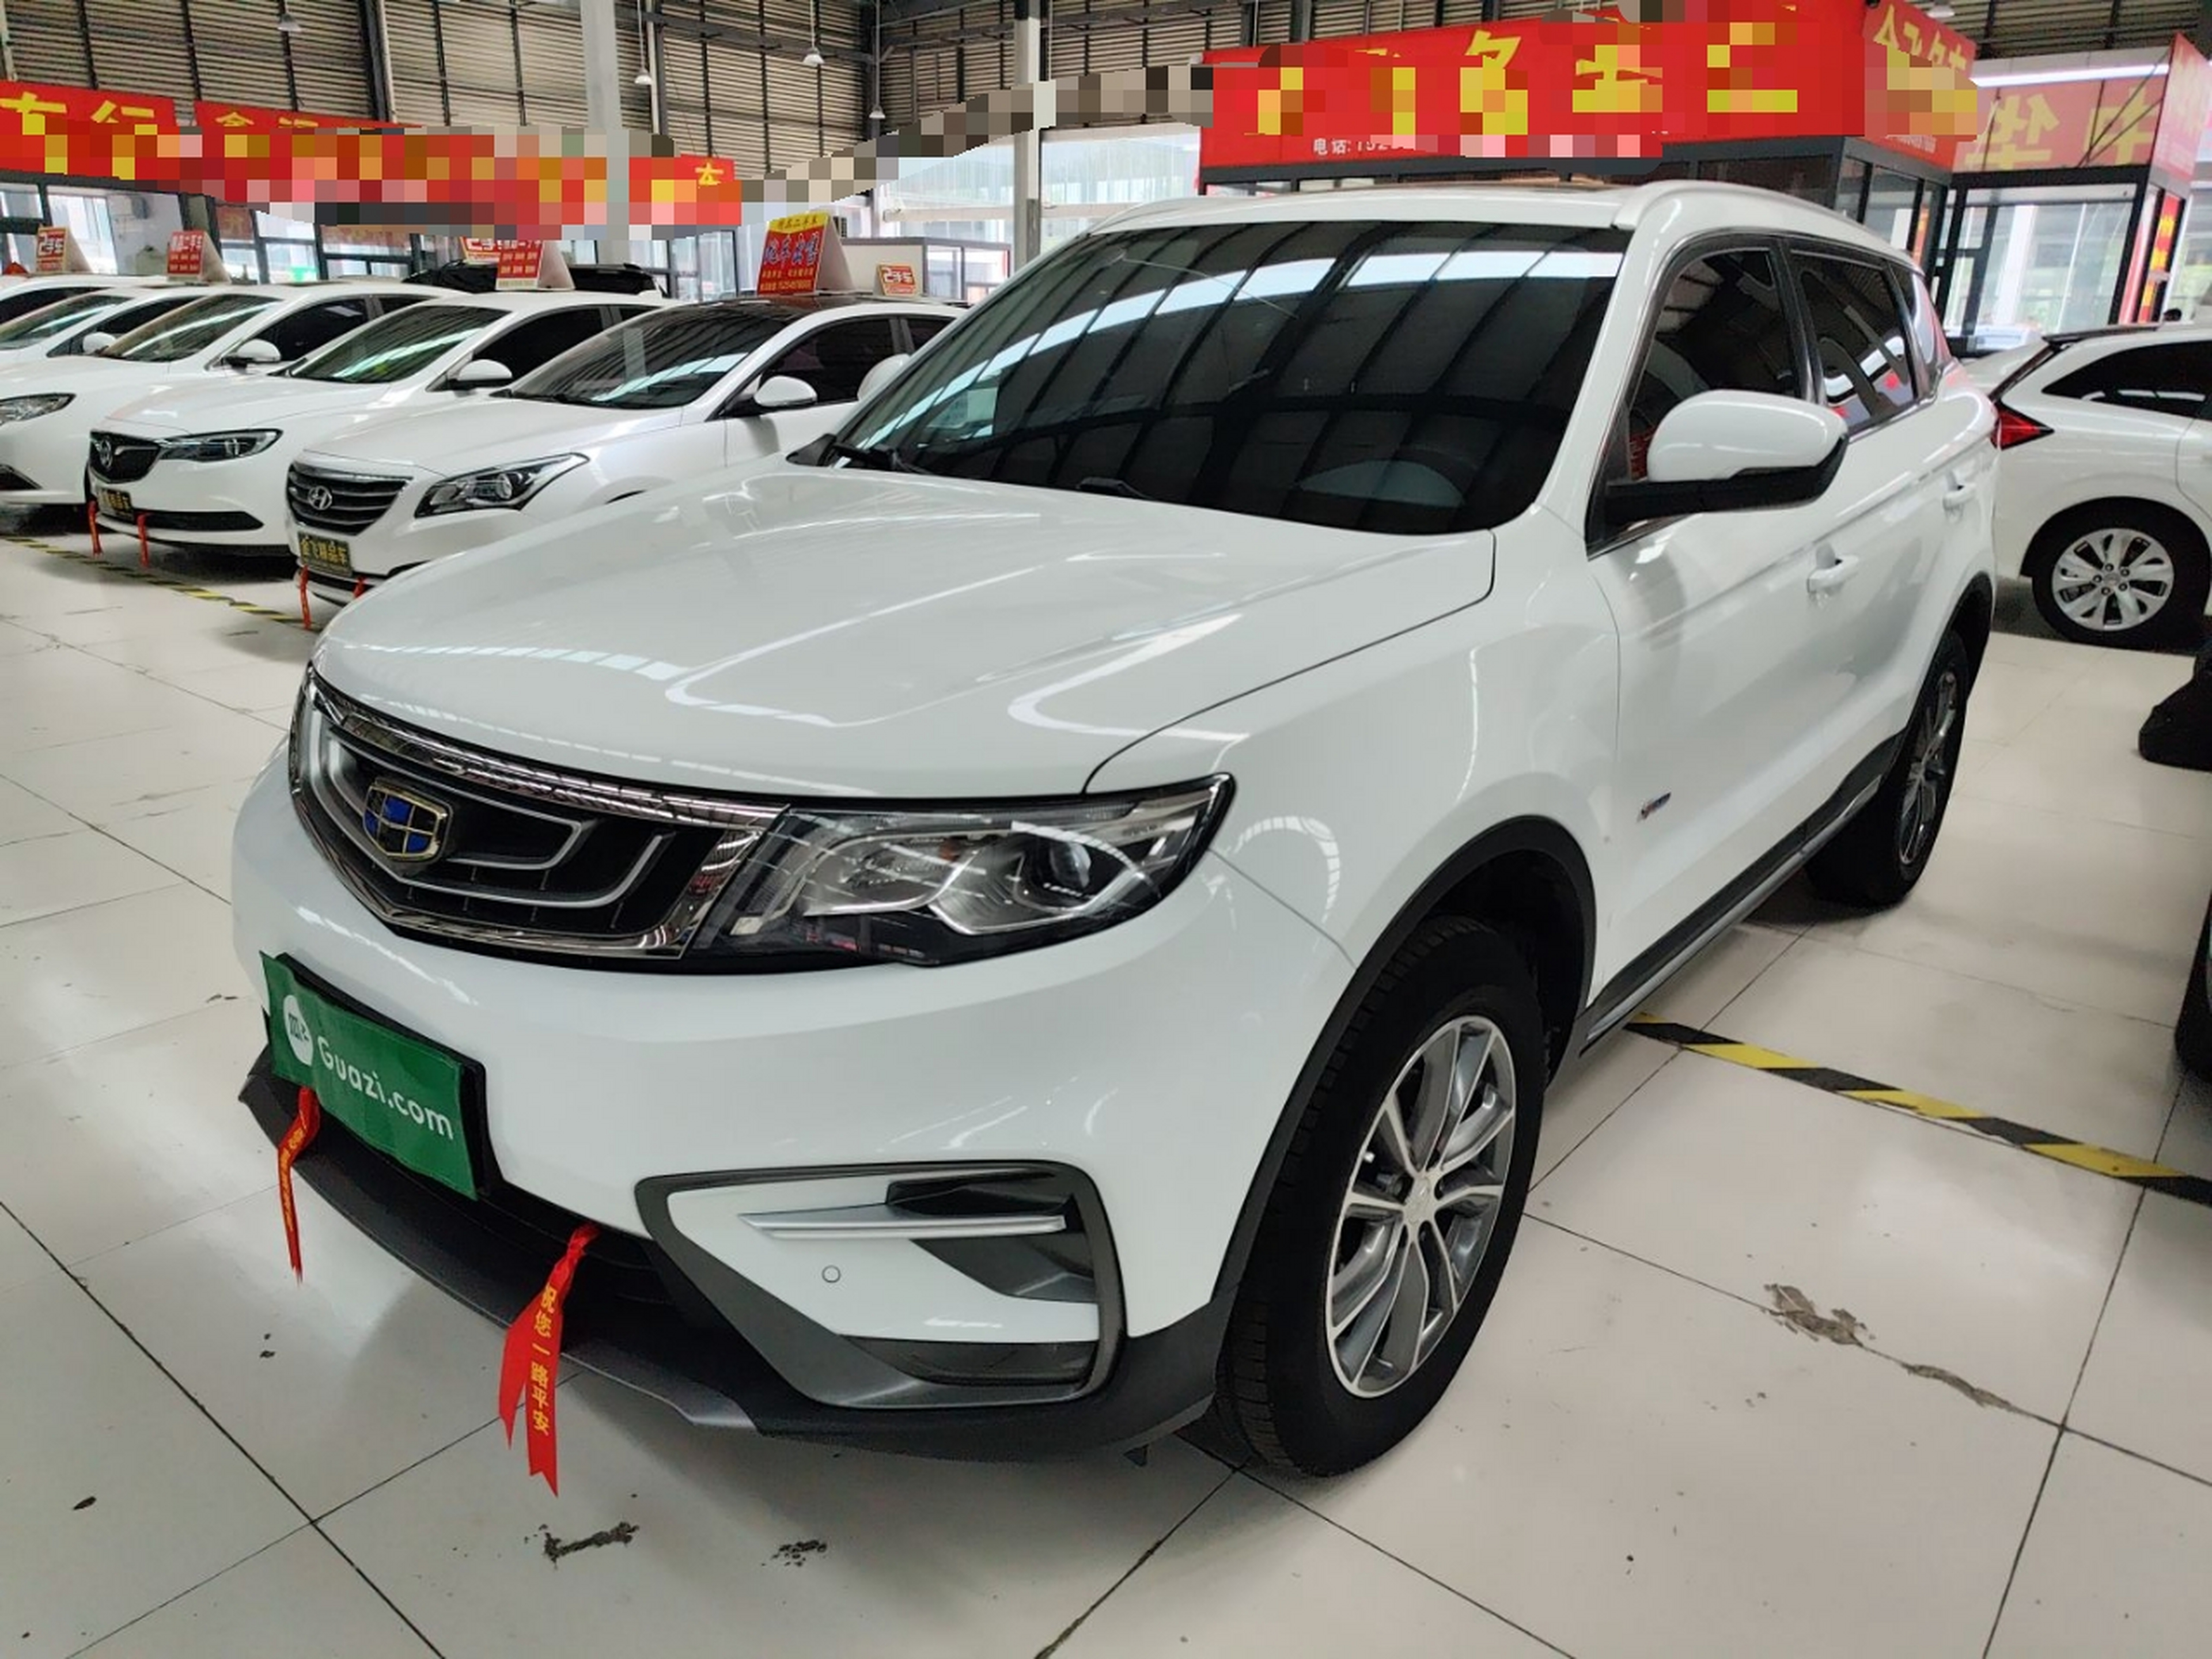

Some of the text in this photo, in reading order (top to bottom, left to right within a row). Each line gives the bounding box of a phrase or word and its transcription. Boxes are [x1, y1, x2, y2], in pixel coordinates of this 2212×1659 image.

[317, 1036, 454, 1140] Guazi.com
[531, 1284, 558, 1436] 祝您一路平安
